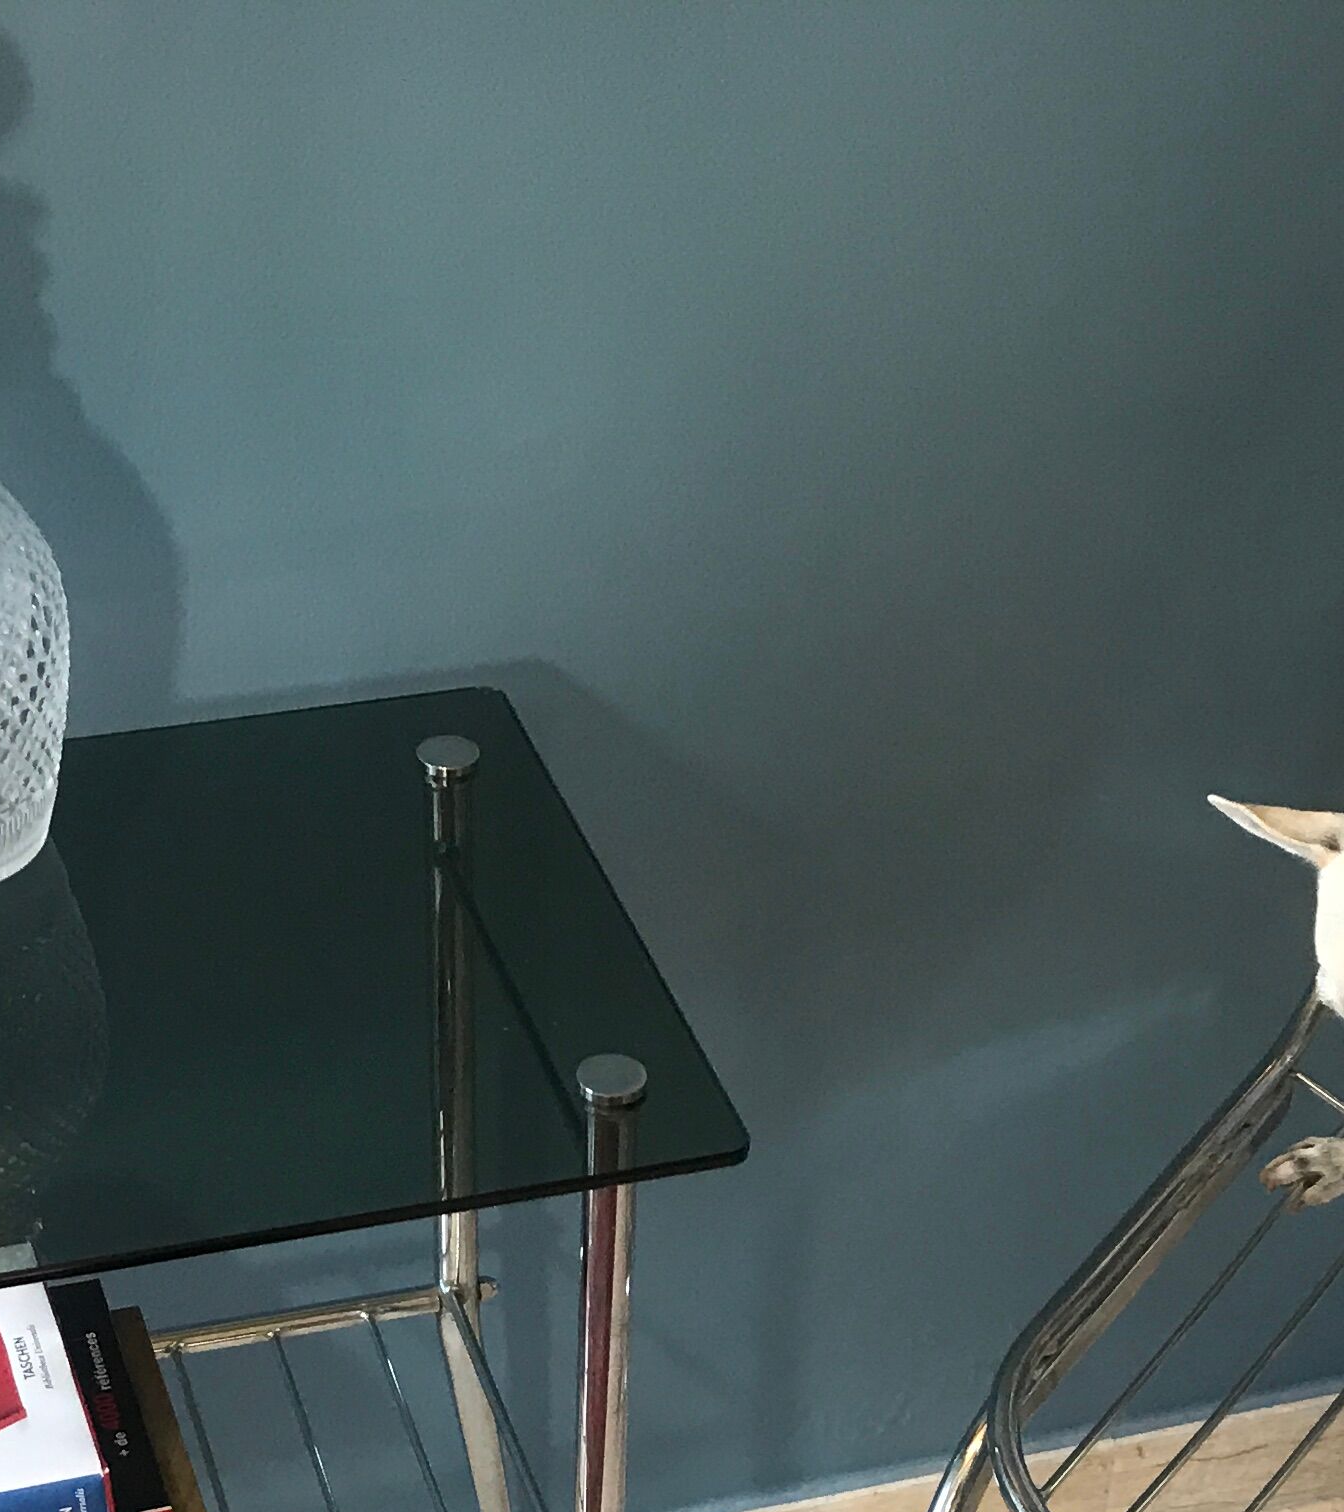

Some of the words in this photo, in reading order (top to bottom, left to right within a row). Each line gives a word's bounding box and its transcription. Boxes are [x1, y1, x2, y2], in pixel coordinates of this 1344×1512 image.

[13, 1336, 35, 1380] TASCHEN
[85, 1332, 112, 1391] références
[114, 1431, 128, 1446] de
